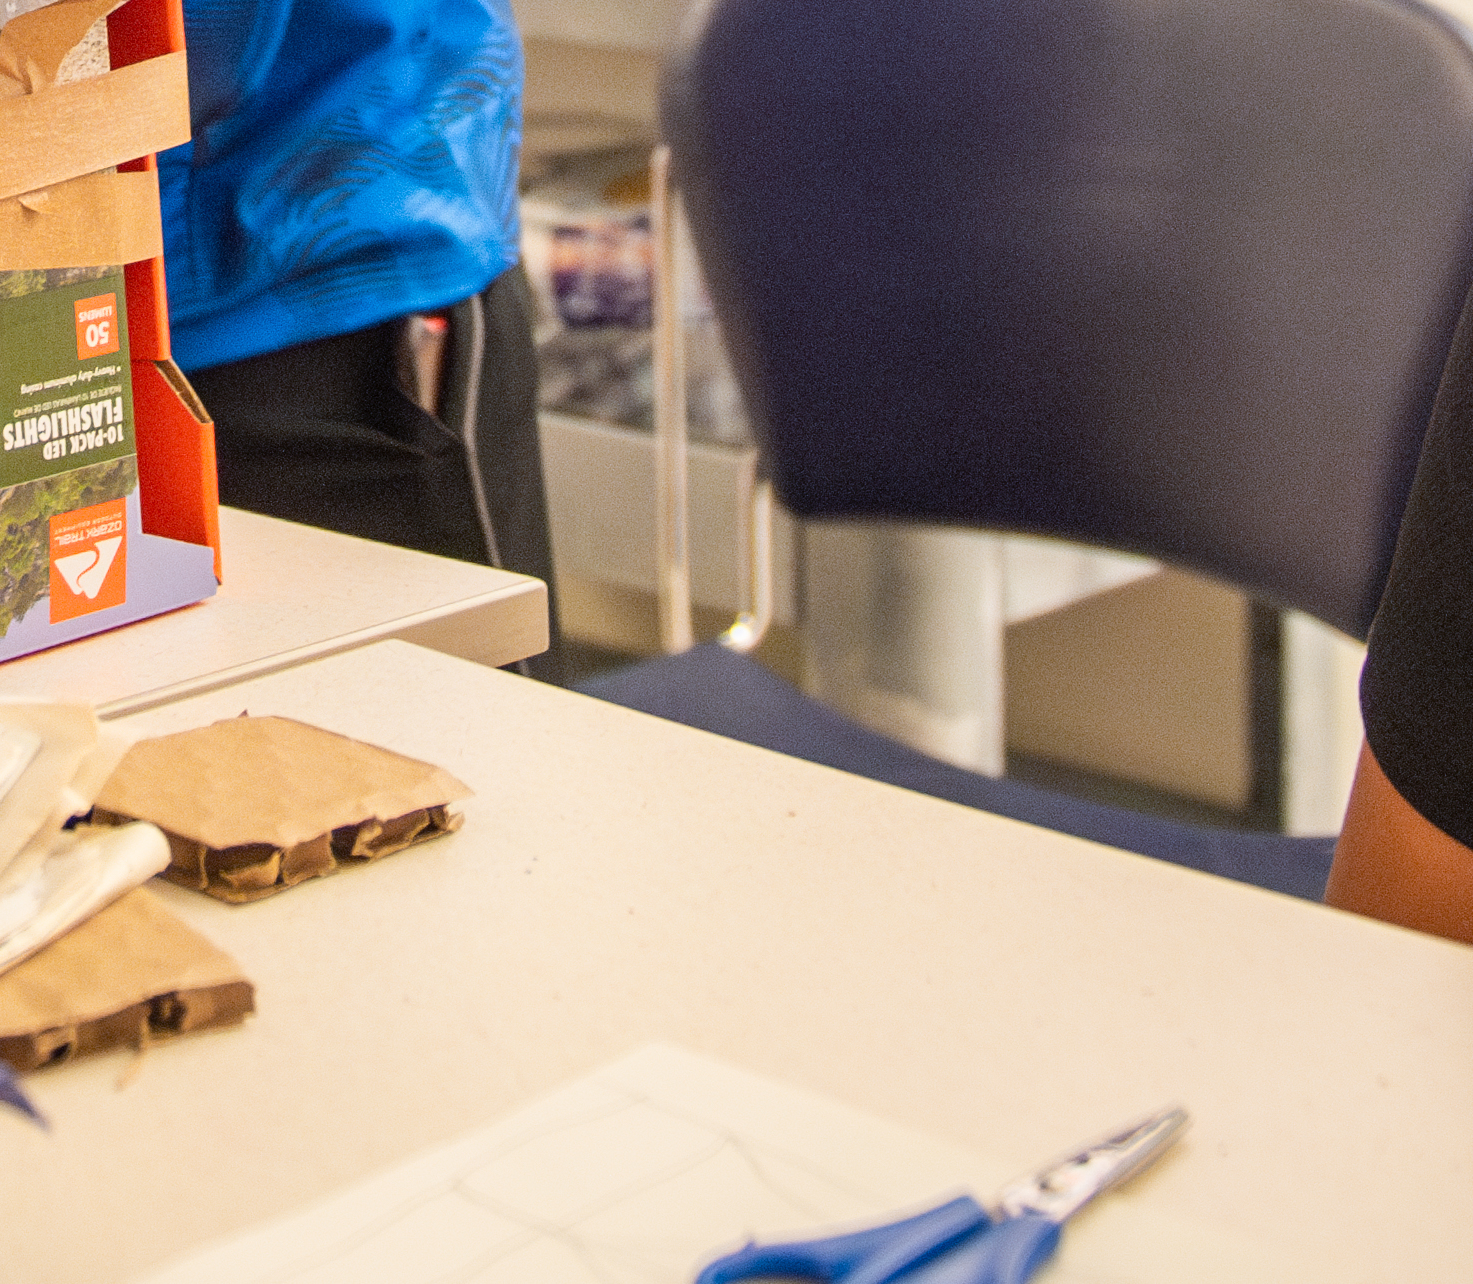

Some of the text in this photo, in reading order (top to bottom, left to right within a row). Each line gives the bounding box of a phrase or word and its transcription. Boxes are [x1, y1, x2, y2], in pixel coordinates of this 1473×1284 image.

[85, 321, 110, 348] 50
[3, 397, 123, 451] FLASHLIGHTS
[43, 423, 124, 460] 10-PACK LED
